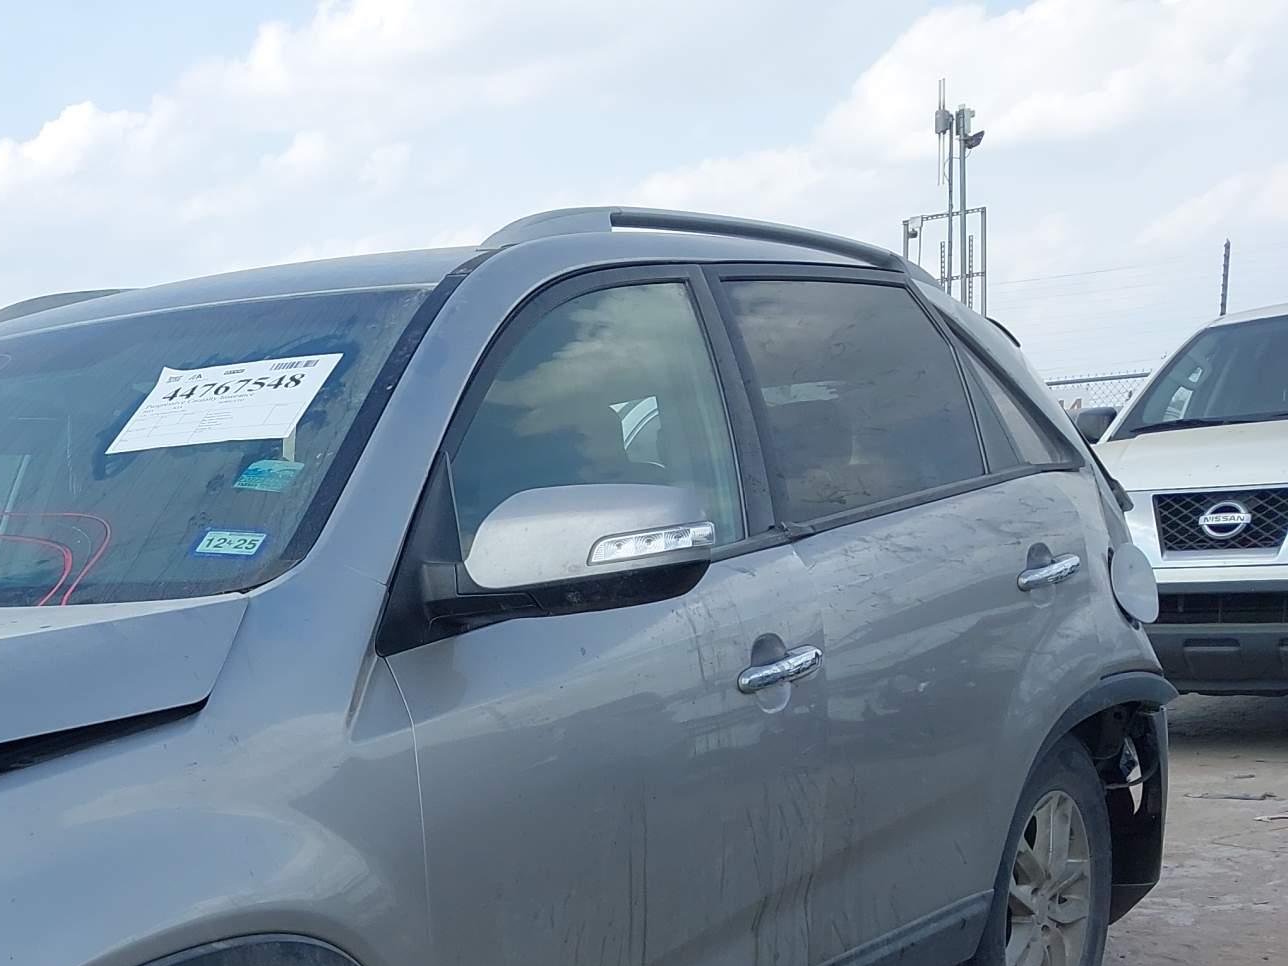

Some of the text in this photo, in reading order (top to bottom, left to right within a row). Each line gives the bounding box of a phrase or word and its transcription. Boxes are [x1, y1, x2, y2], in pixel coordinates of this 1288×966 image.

[162, 373, 306, 401] 44767548
[1203, 514, 1245, 523] NISSAN
[205, 537, 259, 550] 12 25
